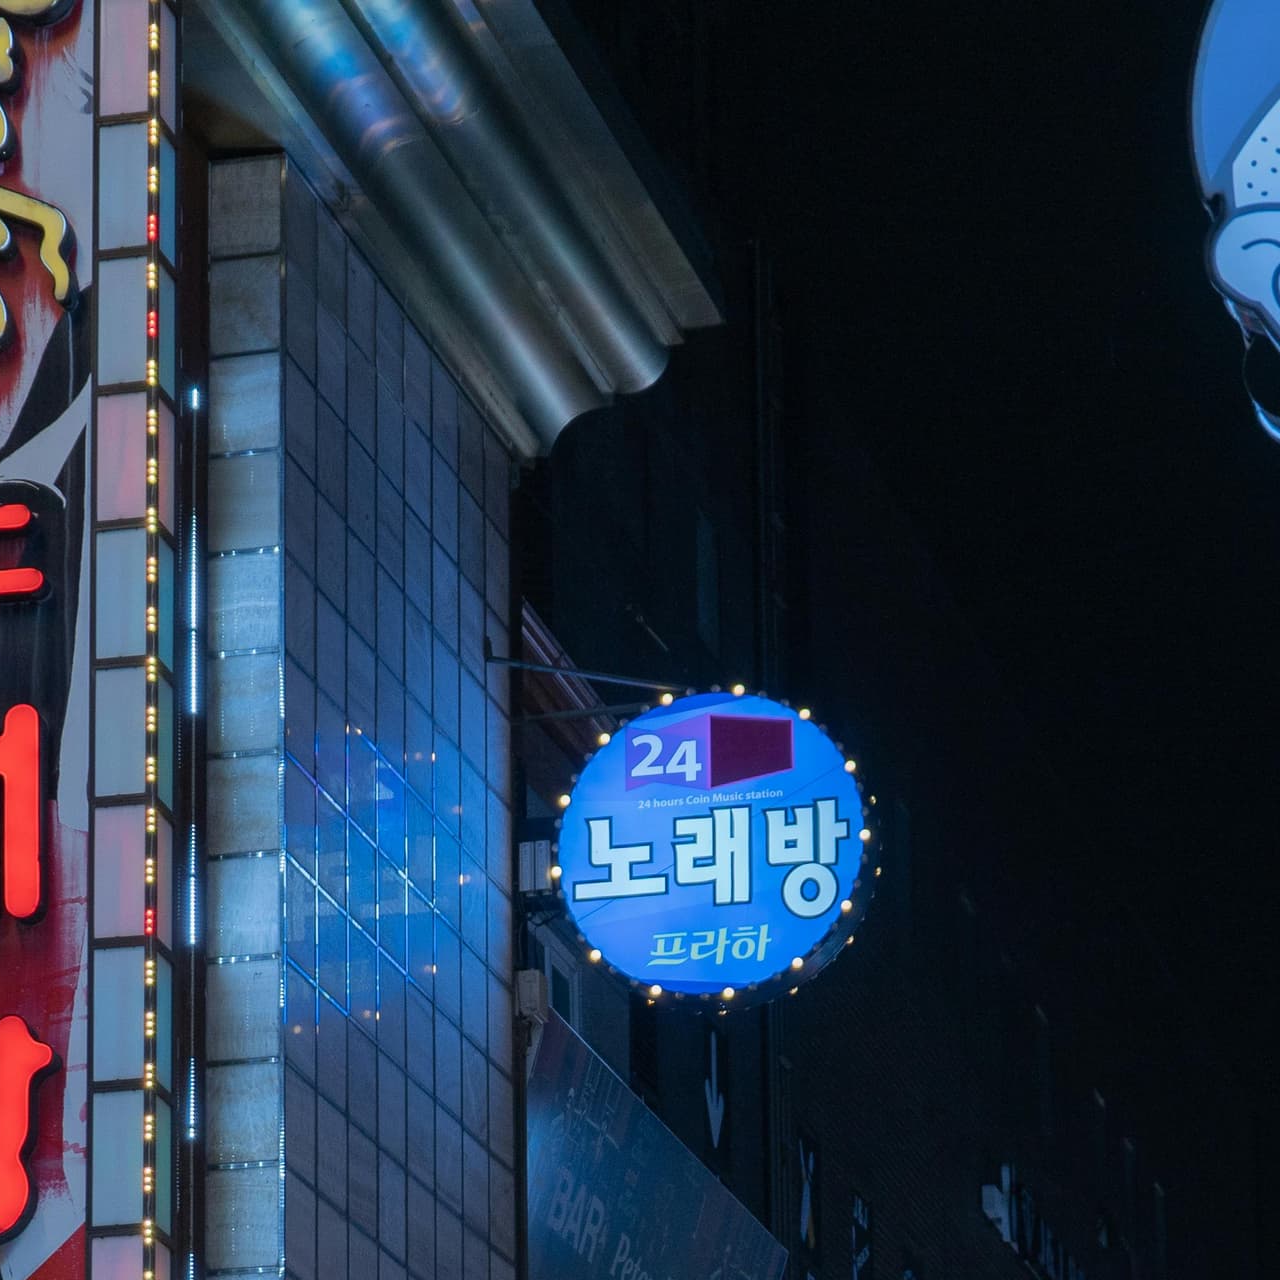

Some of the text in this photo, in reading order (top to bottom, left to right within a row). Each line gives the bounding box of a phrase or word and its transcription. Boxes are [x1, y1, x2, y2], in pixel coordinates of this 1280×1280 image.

[631, 734, 702, 782] 24
[638, 788, 783, 809] 24 hours Coin Music station
[572, 797, 850, 919] 노래방
[647, 924, 772, 966] 프라하
